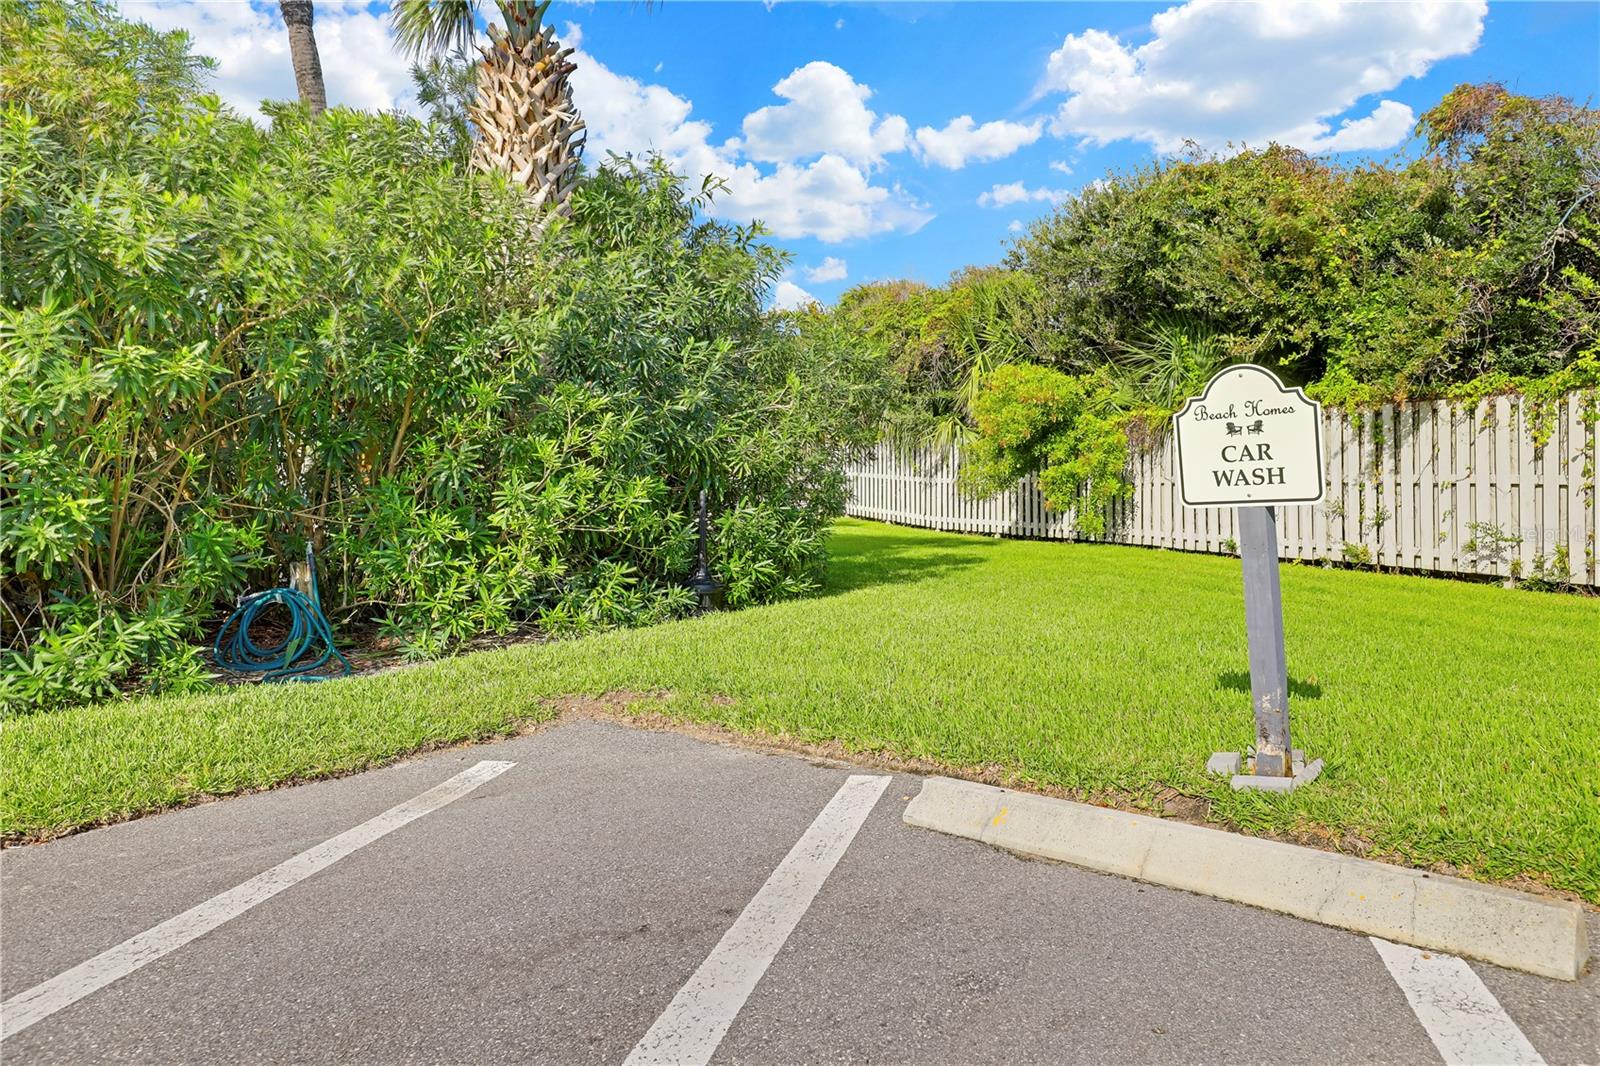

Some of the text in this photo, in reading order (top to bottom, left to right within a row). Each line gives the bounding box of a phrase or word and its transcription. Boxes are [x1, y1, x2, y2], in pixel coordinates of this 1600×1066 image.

[1193, 399, 1296, 422] Beach Homes
[1221, 443, 1274, 463] CAR
[1212, 466, 1286, 487] WASH
